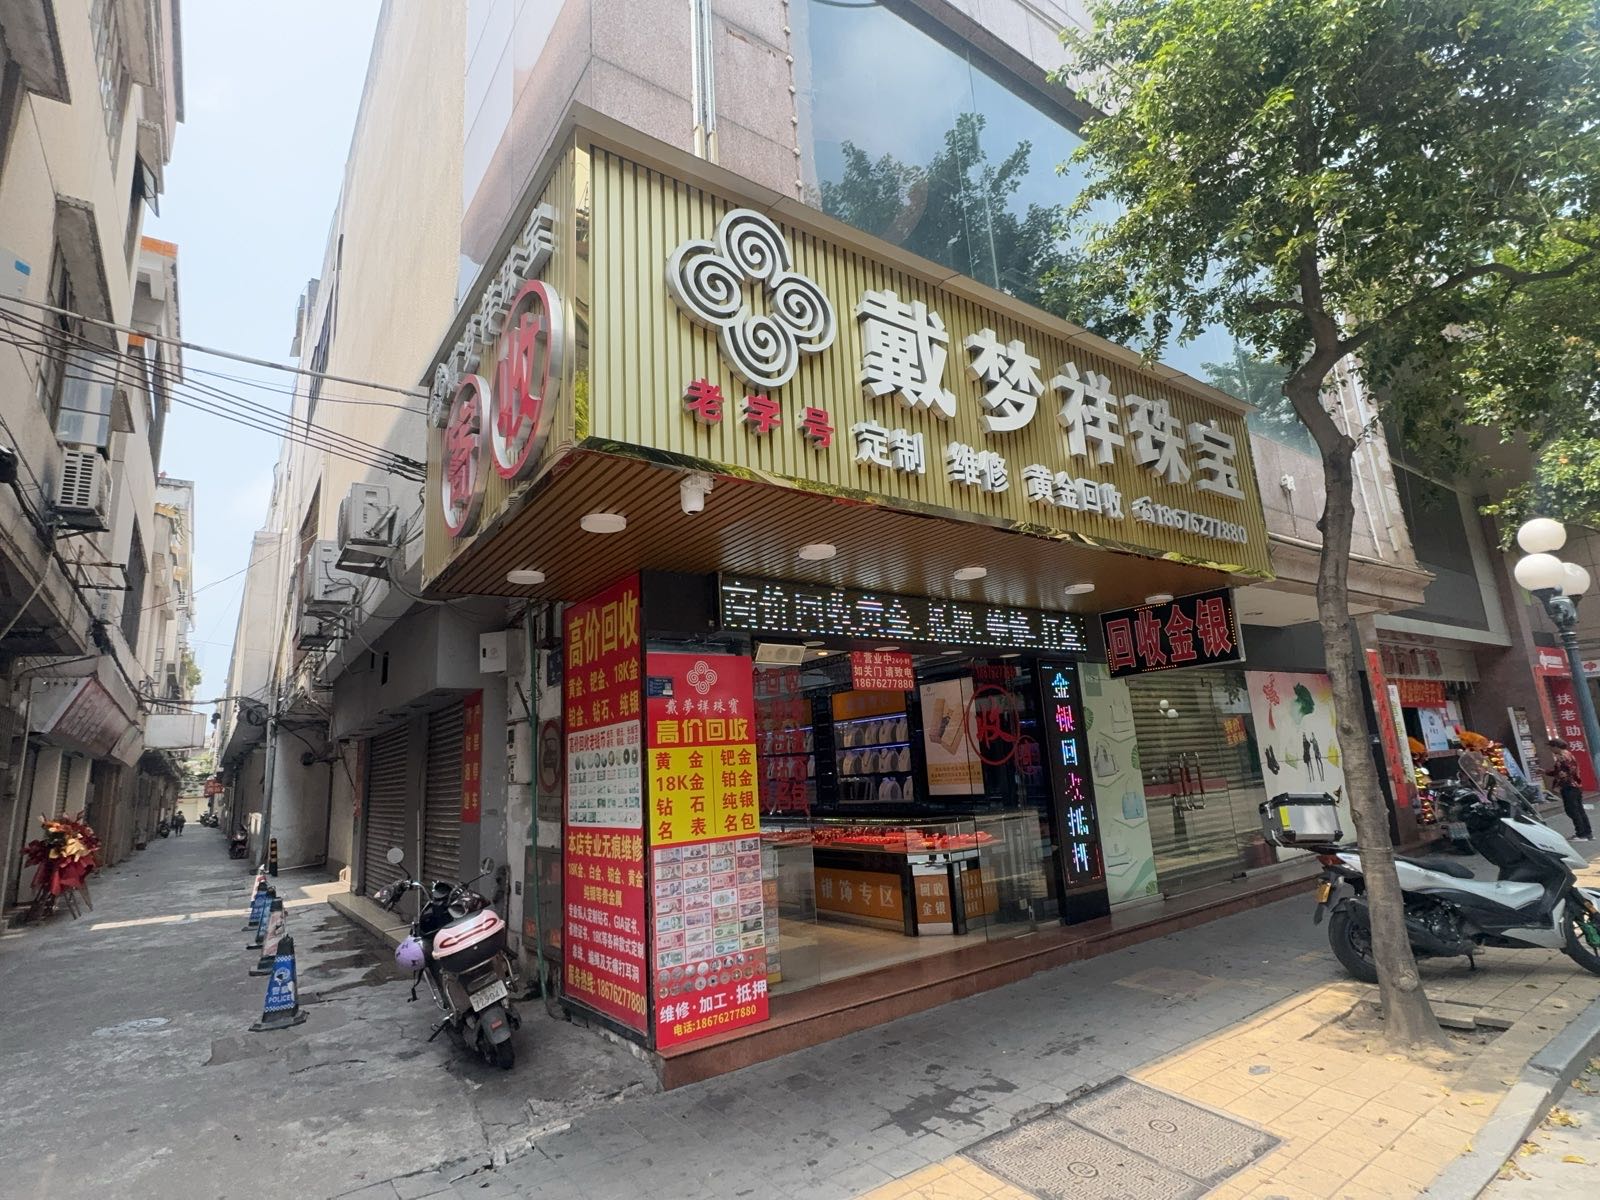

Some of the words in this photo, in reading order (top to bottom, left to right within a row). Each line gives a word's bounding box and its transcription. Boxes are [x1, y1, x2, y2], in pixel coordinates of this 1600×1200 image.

[856, 289, 1245, 501] 戴梦祥珠宝
[683, 377, 834, 451] 老字号
[853, 419, 926, 475] 定制
[946, 442, 1010, 494] 维修
[1022, 463, 1125, 520] 黄金回收
[1155, 506, 1248, 545] 18676277880
[568, 589, 640, 670] 高价回收
[1106, 597, 1231, 670] 回收金银
[854, 665, 882, 677] 如关门
[885, 666, 913, 678] 请致电
[855, 678, 914, 689] 18676277880
[656, 718, 750, 744] 高价回收
[1556, 693, 1585, 752] 扶老助残
[655, 750, 705, 771] 黄金
[720, 748, 752, 767] 钯金
[656, 773, 705, 792] 18K金
[721, 769, 753, 789] 铂金
[656, 796, 705, 817] 钻石
[722, 791, 755, 810] 纯银
[657, 817, 707, 841] 名表
[724, 812, 756, 833] 名包
[568, 831, 643, 863] 本店专业无痕维修
[821, 878, 895, 907] 银饰专区
[919, 882, 945, 897] 回收
[922, 901, 947, 916] 金银
[673, 1004, 757, 1037] 电话:18676277880
